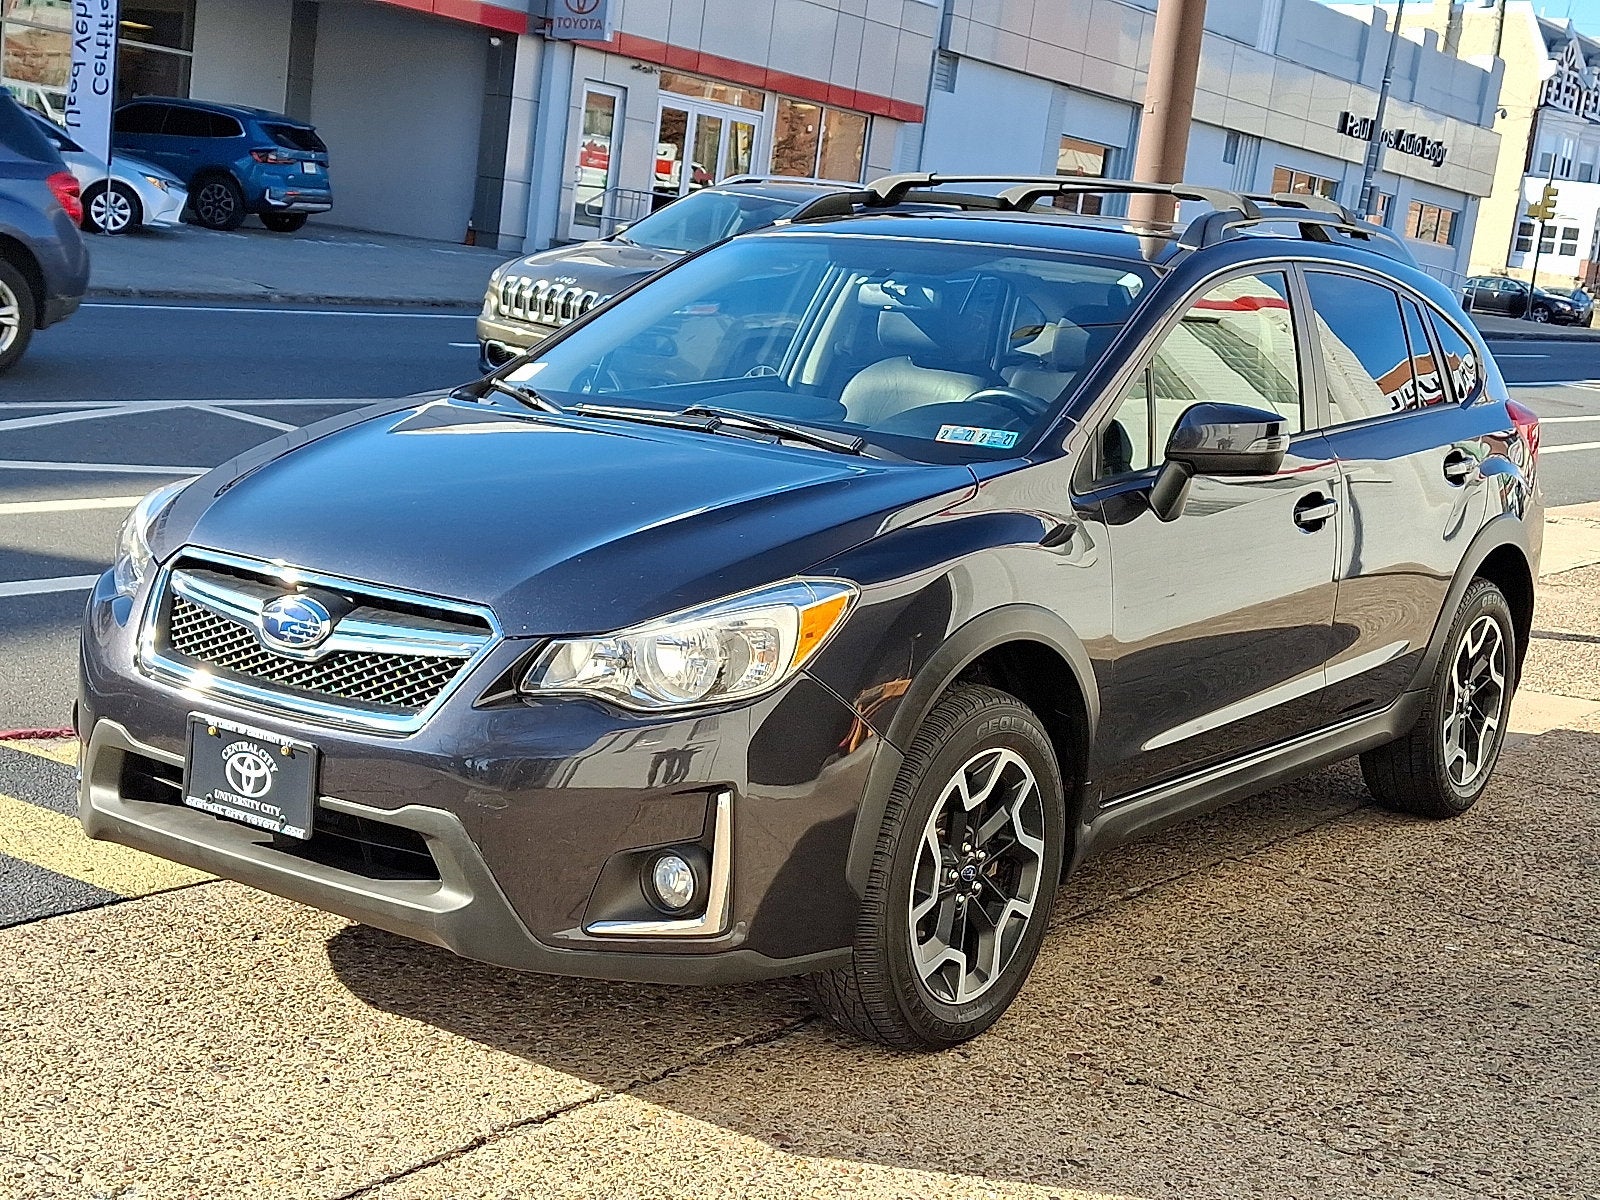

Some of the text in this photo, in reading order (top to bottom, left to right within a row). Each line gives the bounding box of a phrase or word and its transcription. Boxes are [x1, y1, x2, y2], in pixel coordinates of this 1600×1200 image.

[557, 16, 603, 30] TOYOTA
[1343, 111, 1373, 141] Paul
[1398, 131, 1423, 156] Auto
[1423, 138, 1448, 167] Body
[940, 429, 976, 442] 2 27
[979, 433, 1015, 446] 2 27
[221, 741, 279, 773] CENTRAL CITY
[214, 788, 281, 817] UNIVERSITY CITY
